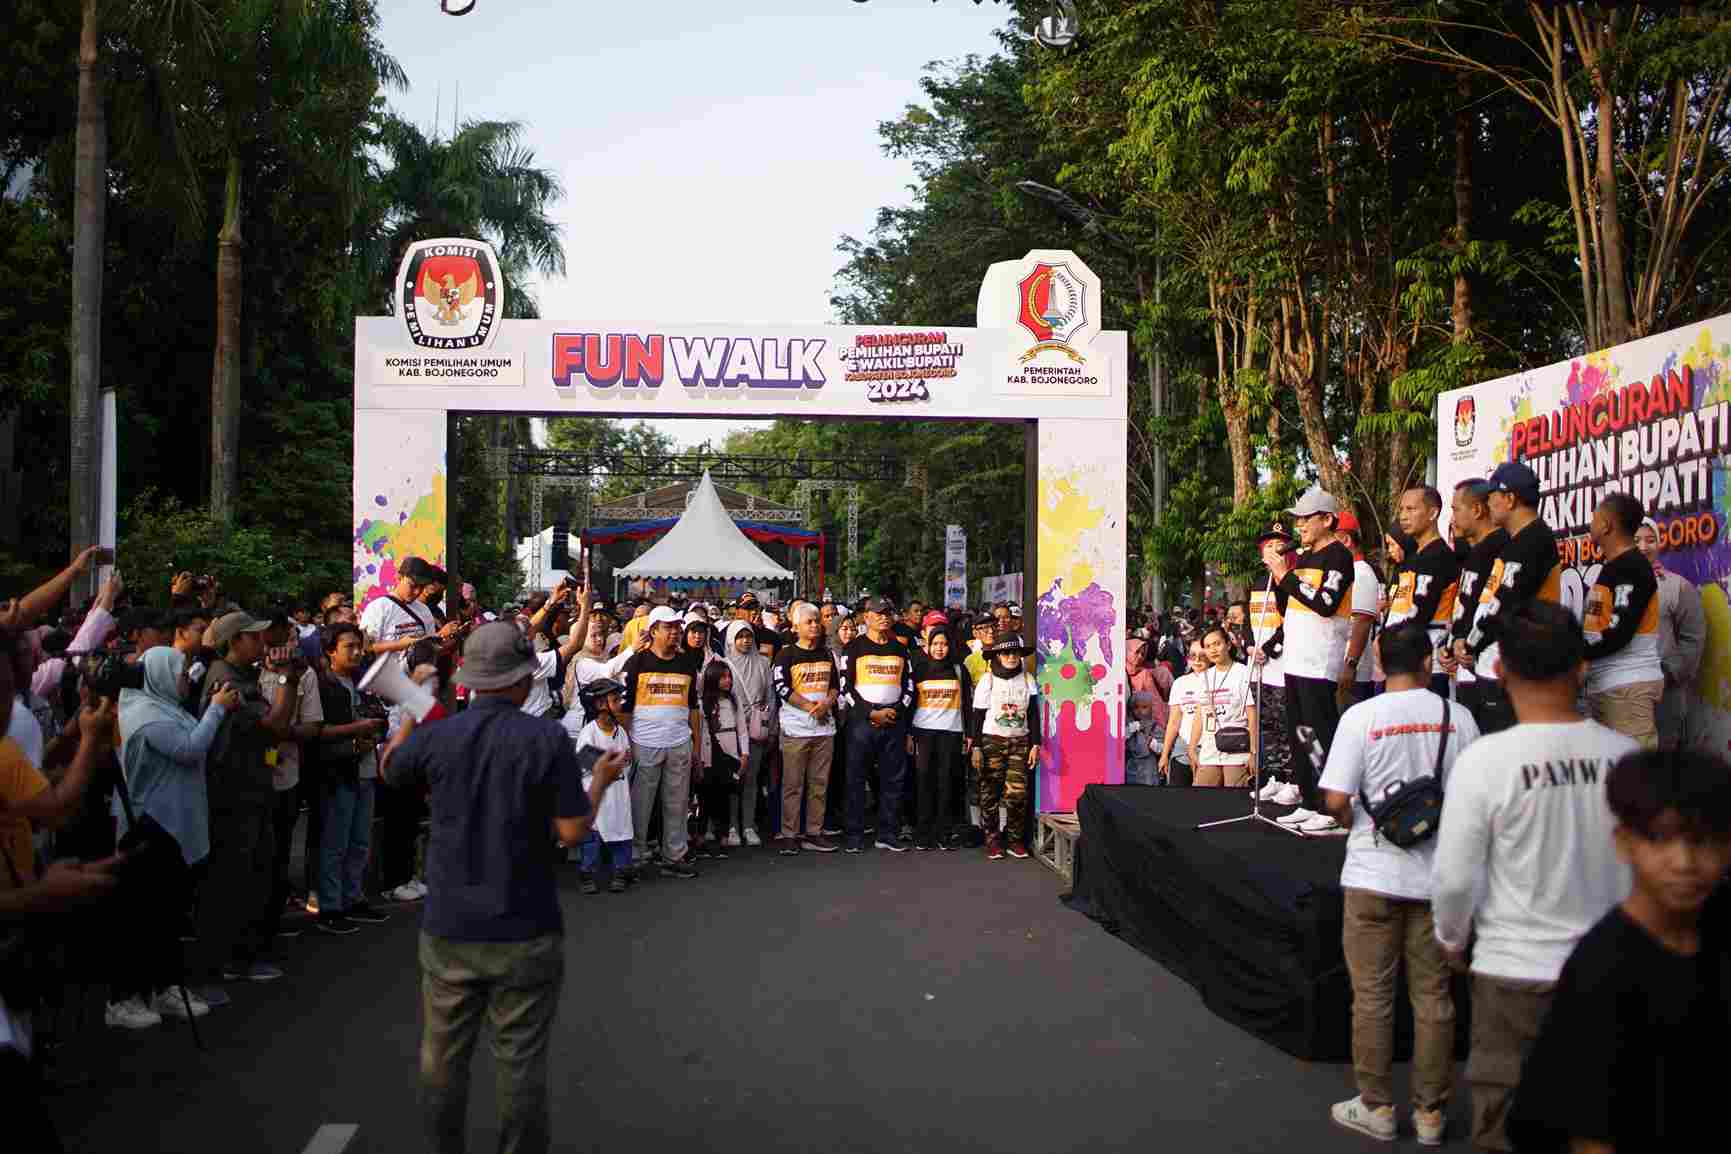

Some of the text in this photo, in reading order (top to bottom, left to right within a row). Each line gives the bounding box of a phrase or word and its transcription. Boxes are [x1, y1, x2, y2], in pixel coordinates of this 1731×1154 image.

[424, 246, 478, 257] KOMISI
[405, 303, 466, 348] PEMILIHAN
[840, 344, 963, 360] PEMILIHAN BUPATI
[385, 358, 512, 367] KOMISI PEMILIHAN UMUM
[552, 333, 826, 388] FUN WALK
[861, 358, 904, 371] WAKIL
[907, 356, 955, 369] BUPATI
[399, 368, 499, 377] KAB. BOJONEGORO
[1023, 366, 1081, 375] PEMERINTAH
[1031, 375, 1098, 385] BOJONEGORO
[868, 379, 929, 402] 2024
[1511, 365, 1693, 465] PELUNCURAN
[1621, 400, 1729, 473] BUPATI
[1537, 486, 1594, 531] AKIL
